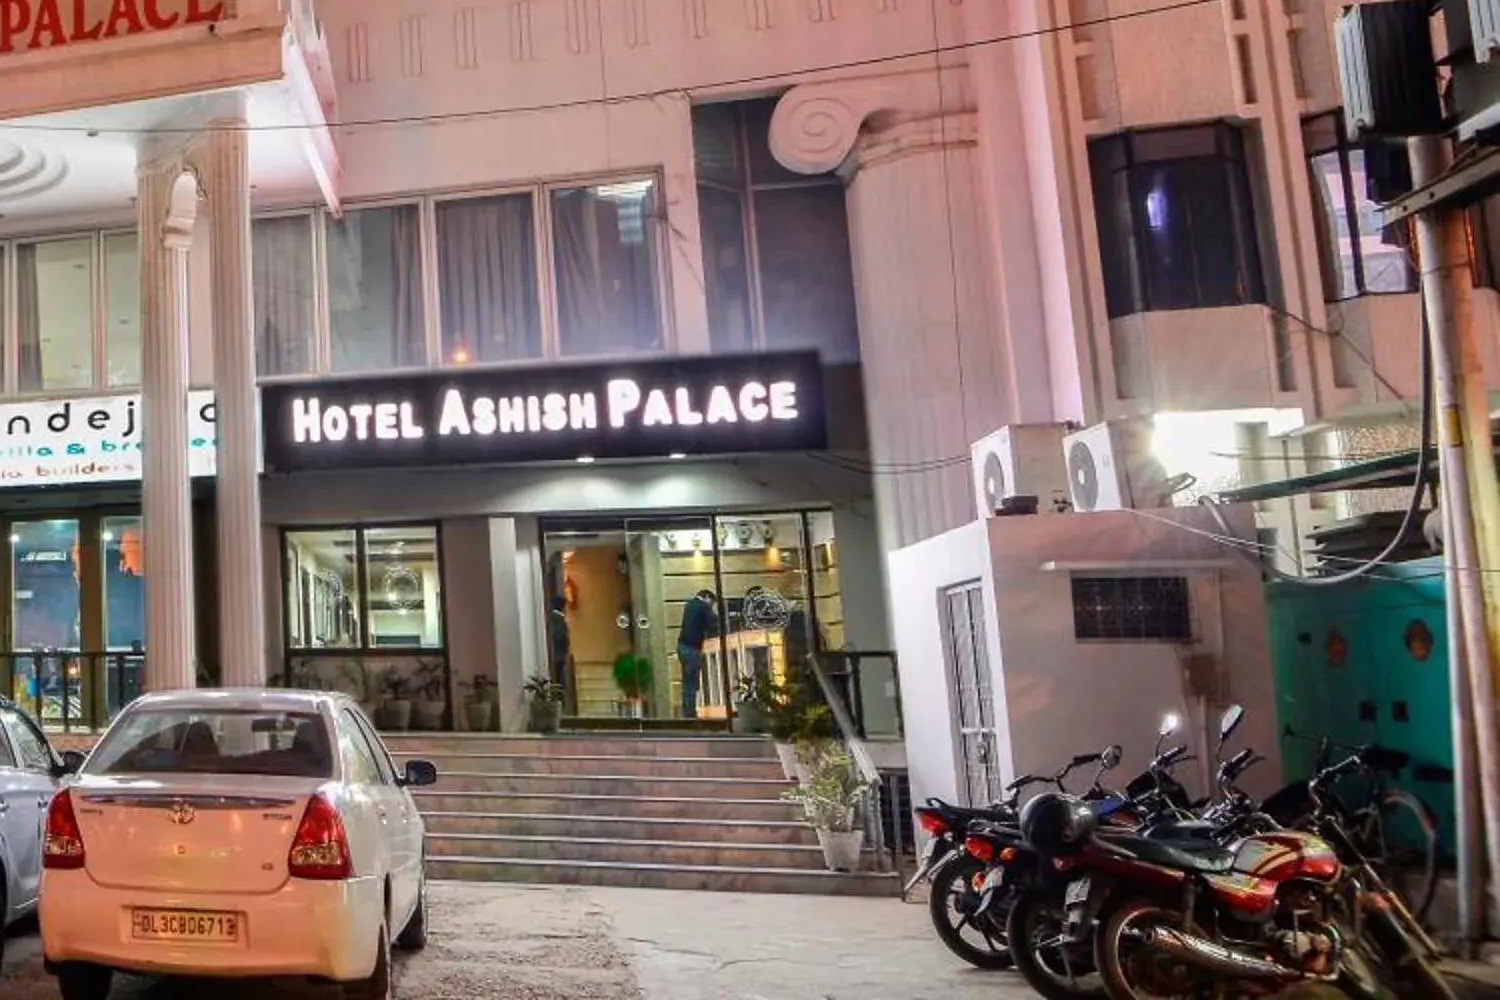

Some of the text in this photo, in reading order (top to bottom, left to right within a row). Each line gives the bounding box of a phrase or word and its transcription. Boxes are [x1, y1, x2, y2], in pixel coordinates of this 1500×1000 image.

[292, 379, 799, 442] HOTEL ASHISH PALACE
[67, 443, 85, 455] &
